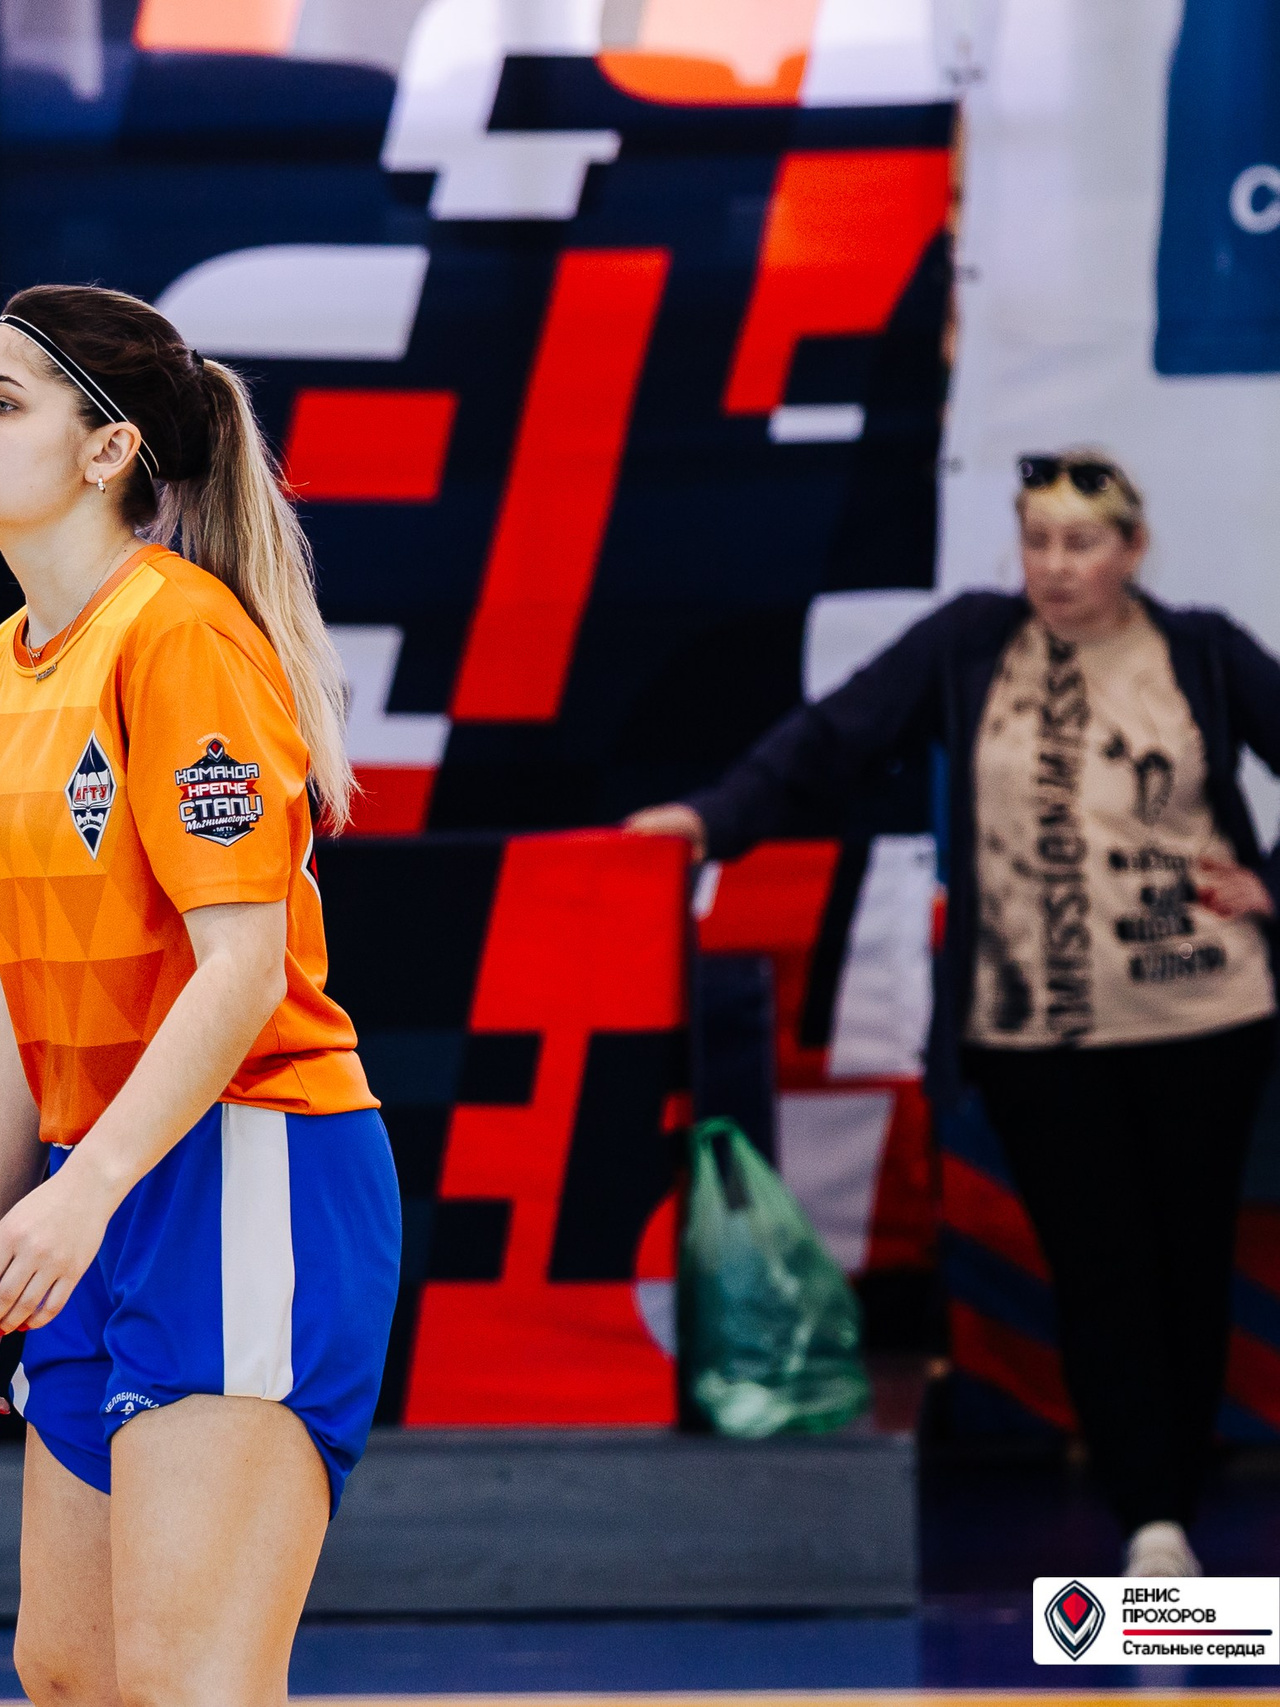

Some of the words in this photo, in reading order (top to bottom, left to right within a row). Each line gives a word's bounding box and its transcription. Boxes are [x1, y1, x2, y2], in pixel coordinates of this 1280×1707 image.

[175, 764, 258, 785] КОМАНДА
[187, 782, 249, 798] КРЕПЧЕ
[180, 796, 263, 821] СТАЛИ
